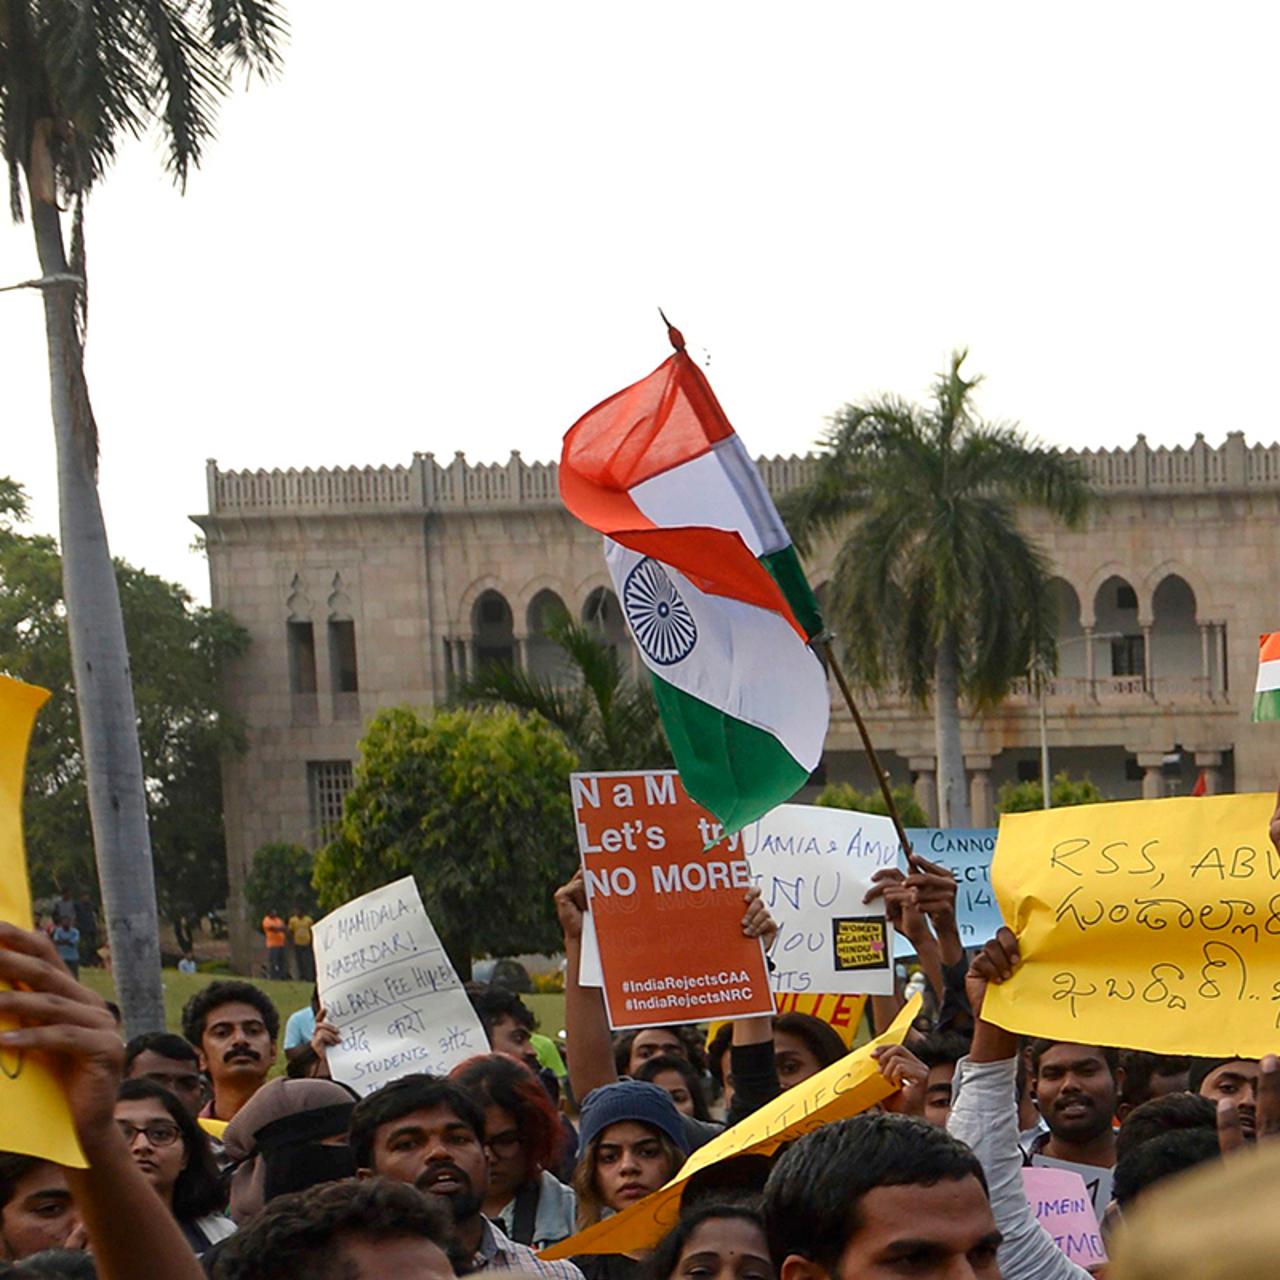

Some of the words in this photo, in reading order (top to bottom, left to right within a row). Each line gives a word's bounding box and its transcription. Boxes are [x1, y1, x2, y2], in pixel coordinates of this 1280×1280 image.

[573, 774, 694, 809] NaM
[578, 820, 666, 853] Let's
[746, 821, 821, 856] JAMIA
[931, 832, 998, 854] CANNO
[584, 867, 637, 898] NO
[652, 860, 752, 893] MORE
[1051, 838, 1165, 889] RSS,
[622, 970, 750, 994] #IndiaRejectsCAA
[625, 988, 753, 1011] #IndiaRejectsNRC
[351, 1047, 429, 1081] STUDENTS
